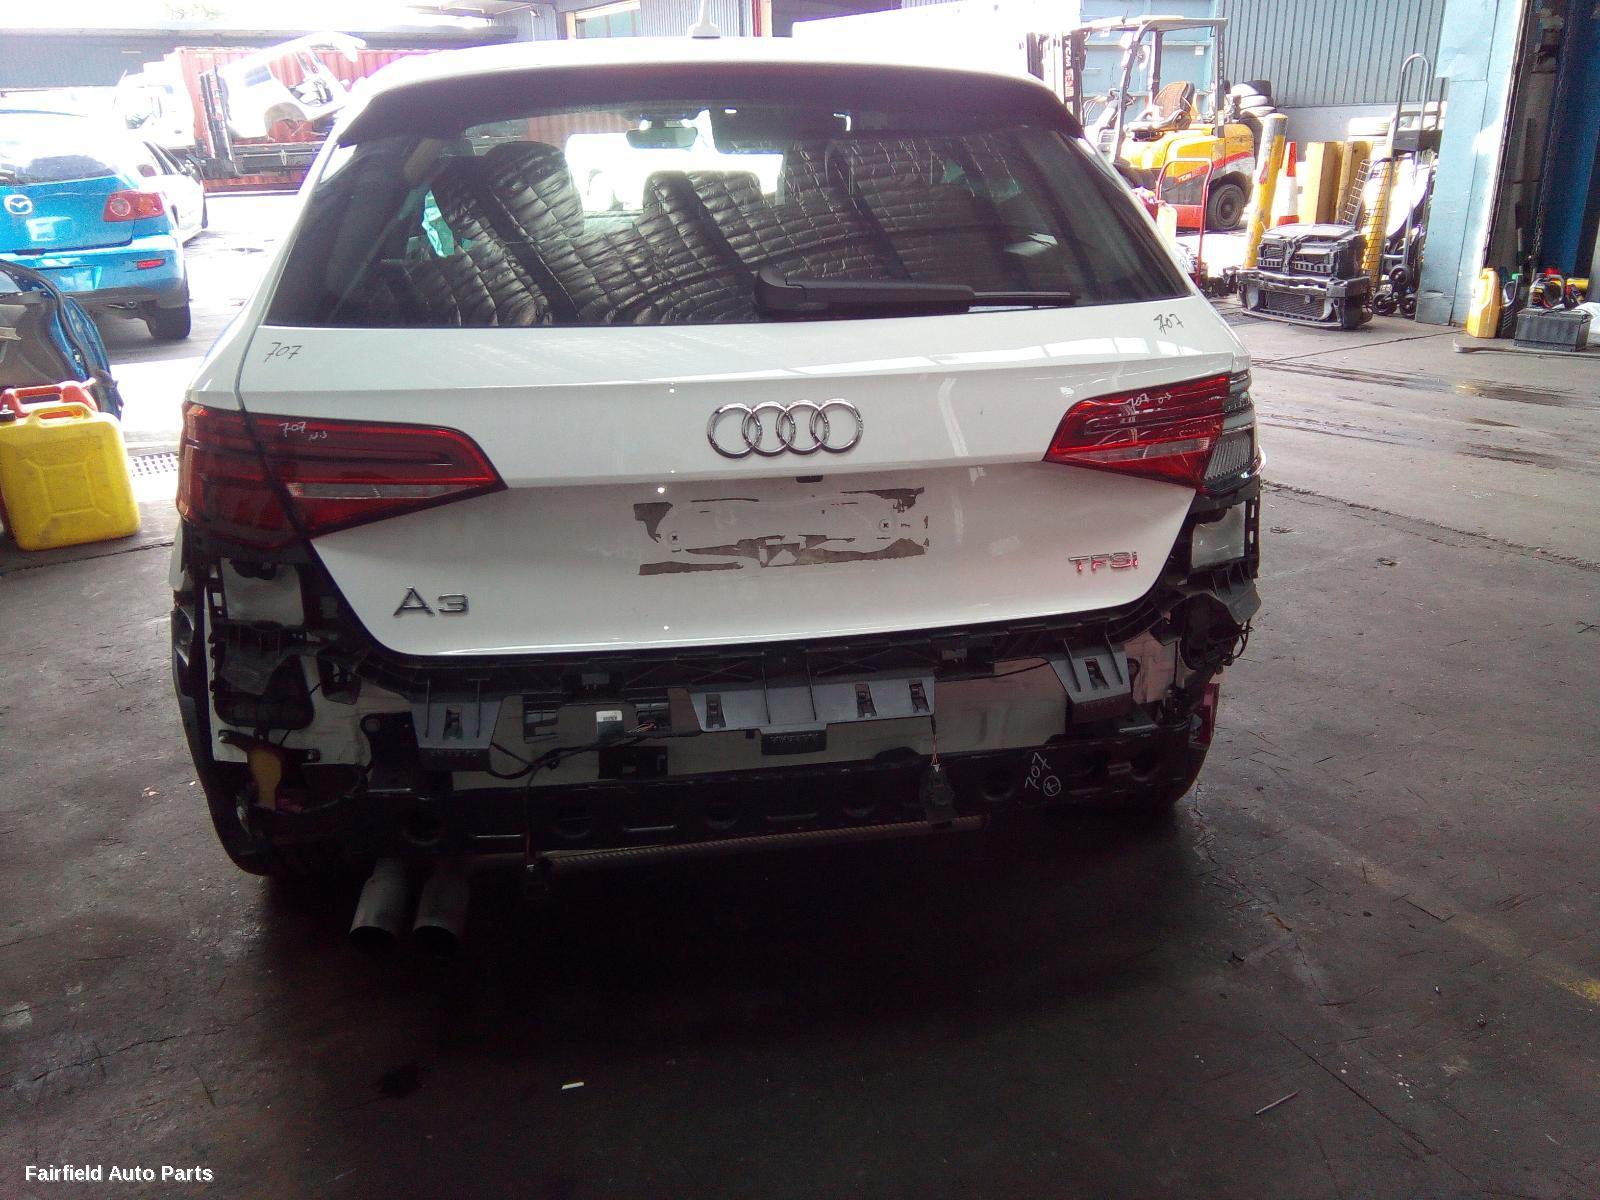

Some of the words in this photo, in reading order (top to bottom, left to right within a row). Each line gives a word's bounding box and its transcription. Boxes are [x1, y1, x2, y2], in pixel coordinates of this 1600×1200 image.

[1065, 38, 1073, 67] TCM
[264, 342, 302, 362] 707
[279, 421, 306, 438] 707
[393, 586, 470, 617] A3
